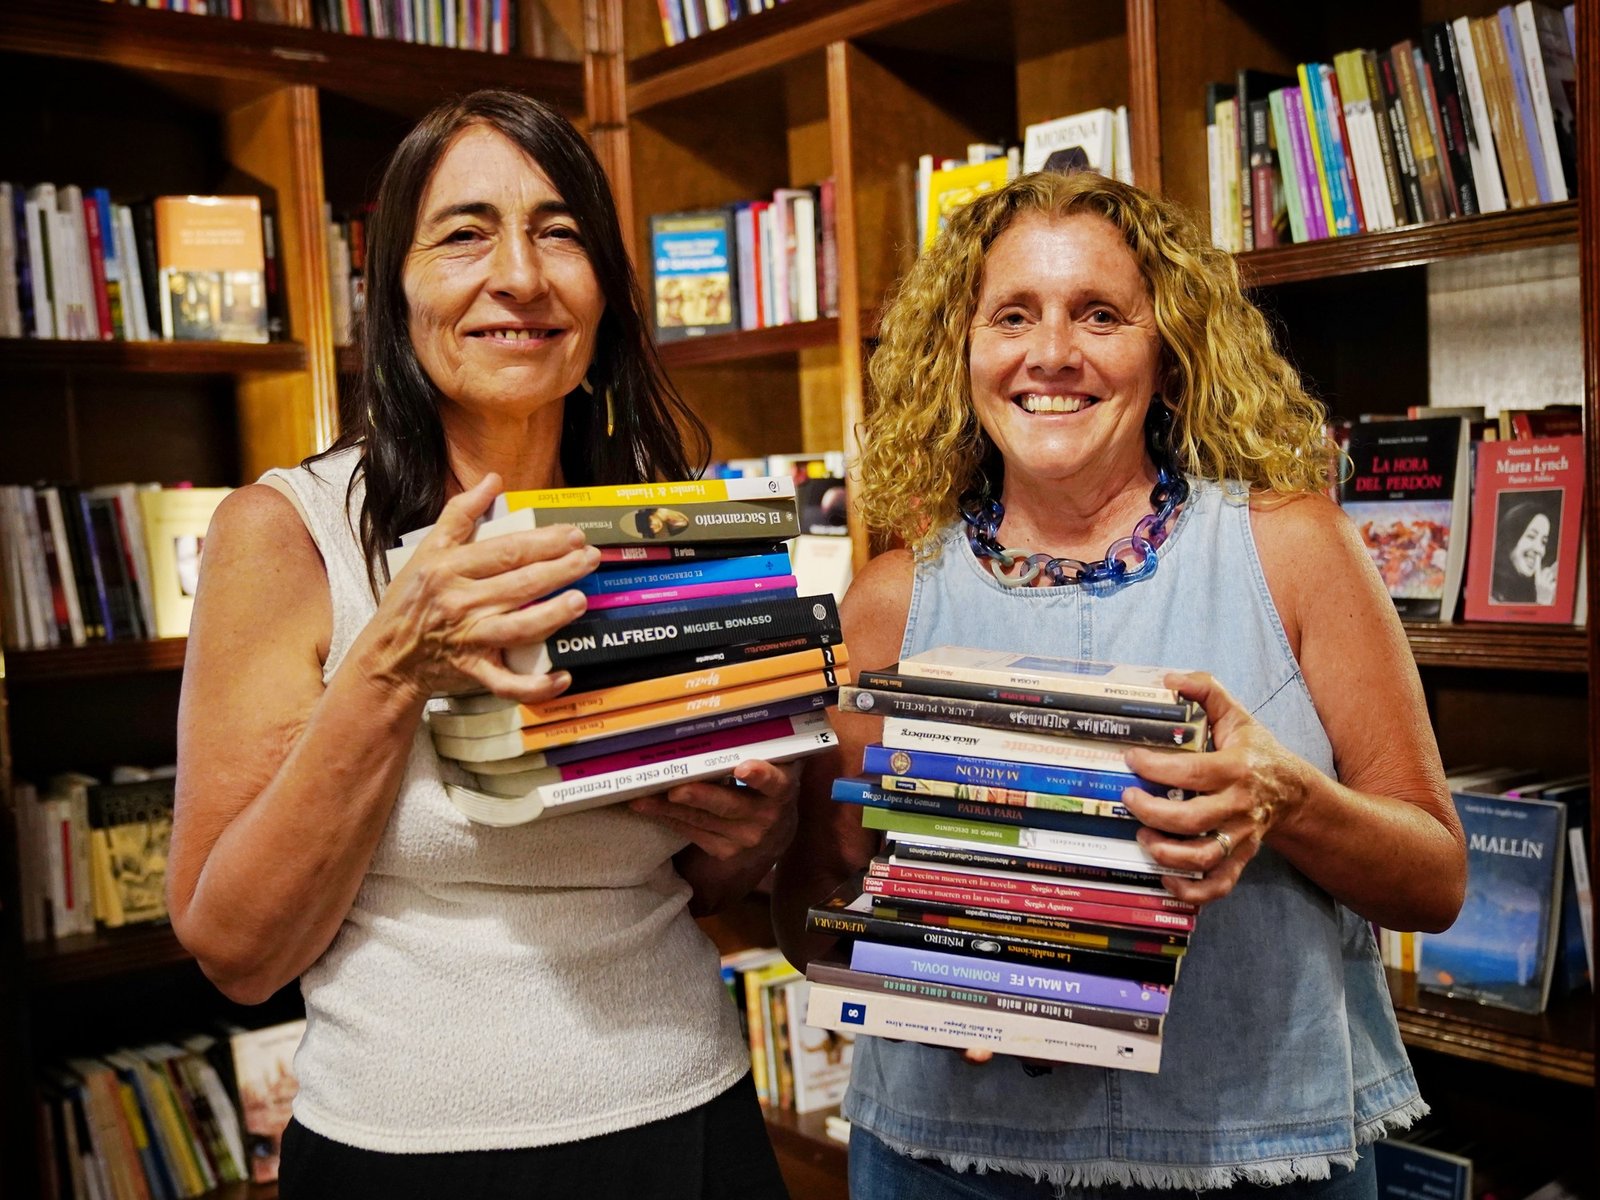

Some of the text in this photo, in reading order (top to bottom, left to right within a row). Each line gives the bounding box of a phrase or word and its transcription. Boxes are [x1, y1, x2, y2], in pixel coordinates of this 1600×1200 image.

[1496, 456, 1569, 476] Marta Lynch
[1356, 477, 1383, 491] DEL
[538, 492, 590, 503] Liliana Heer
[617, 485, 704, 498] Hamlet & Hamlet
[695, 512, 780, 525] El Sacramento
[604, 578, 631, 586] BESTIAS
[659, 571, 692, 580] DERECHO
[558, 615, 772, 653] DON ALFREDO MIGUEL BONASSO
[696, 653, 724, 662] Diamante
[894, 701, 937, 712] PURCELL
[941, 706, 974, 716] LAURA
[718, 715, 742, 725] Bossert
[743, 710, 768, 719] Gustavo
[1009, 712, 1069, 727] SILENCIOSAS
[901, 729, 979, 745] Alicia Steimberg
[1003, 741, 1071, 758] inocente
[553, 753, 740, 800] BUSQUED Bajo este sol tremendo
[956, 765, 1018, 780] MARION
[1046, 777, 1126, 792] ICTORIA BAYONA
[862, 791, 881, 801] Diego
[882, 794, 902, 803] López
[958, 804, 1022, 819] PATRIA PARIA
[935, 824, 969, 833] DESCUENTO
[980, 830, 1002, 838] TIEMPO
[1050, 839, 1107, 850] Clara Benedetti
[1469, 833, 1544, 860] MALLÍN
[909, 848, 1009, 864] Movimiento Cultural Acercándonos
[900, 869, 911, 877] Los
[913, 872, 939, 880] vecinos
[976, 877, 985, 886] las
[986, 881, 1016, 889] novelas
[1031, 884, 1052, 894] Sergio
[1054, 887, 1080, 896] Aguirre
[893, 883, 904, 892] Los
[907, 887, 932, 895] vecinos
[969, 892, 979, 901] las
[980, 895, 1010, 904] novelas
[1024, 899, 1046, 909] Sergio
[1047, 902, 1073, 911] Aguirre
[965, 908, 988, 917] sagrados
[989, 910, 1011, 920] destinos
[1054, 921, 1069, 929] Pablo
[1155, 915, 1188, 925] norma
[815, 917, 1070, 962] Las maldiciones PIÑEIRO ALFAGUARA
[911, 960, 1080, 993] LA MALA FE ROMINA DOVAL
[884, 980, 1072, 1018] la letra del malón FACUNDO GÓMEZ ROMERO
[905, 1023, 928, 1031] Buenos
[1044, 1038, 1097, 1050] Leandro Losada
